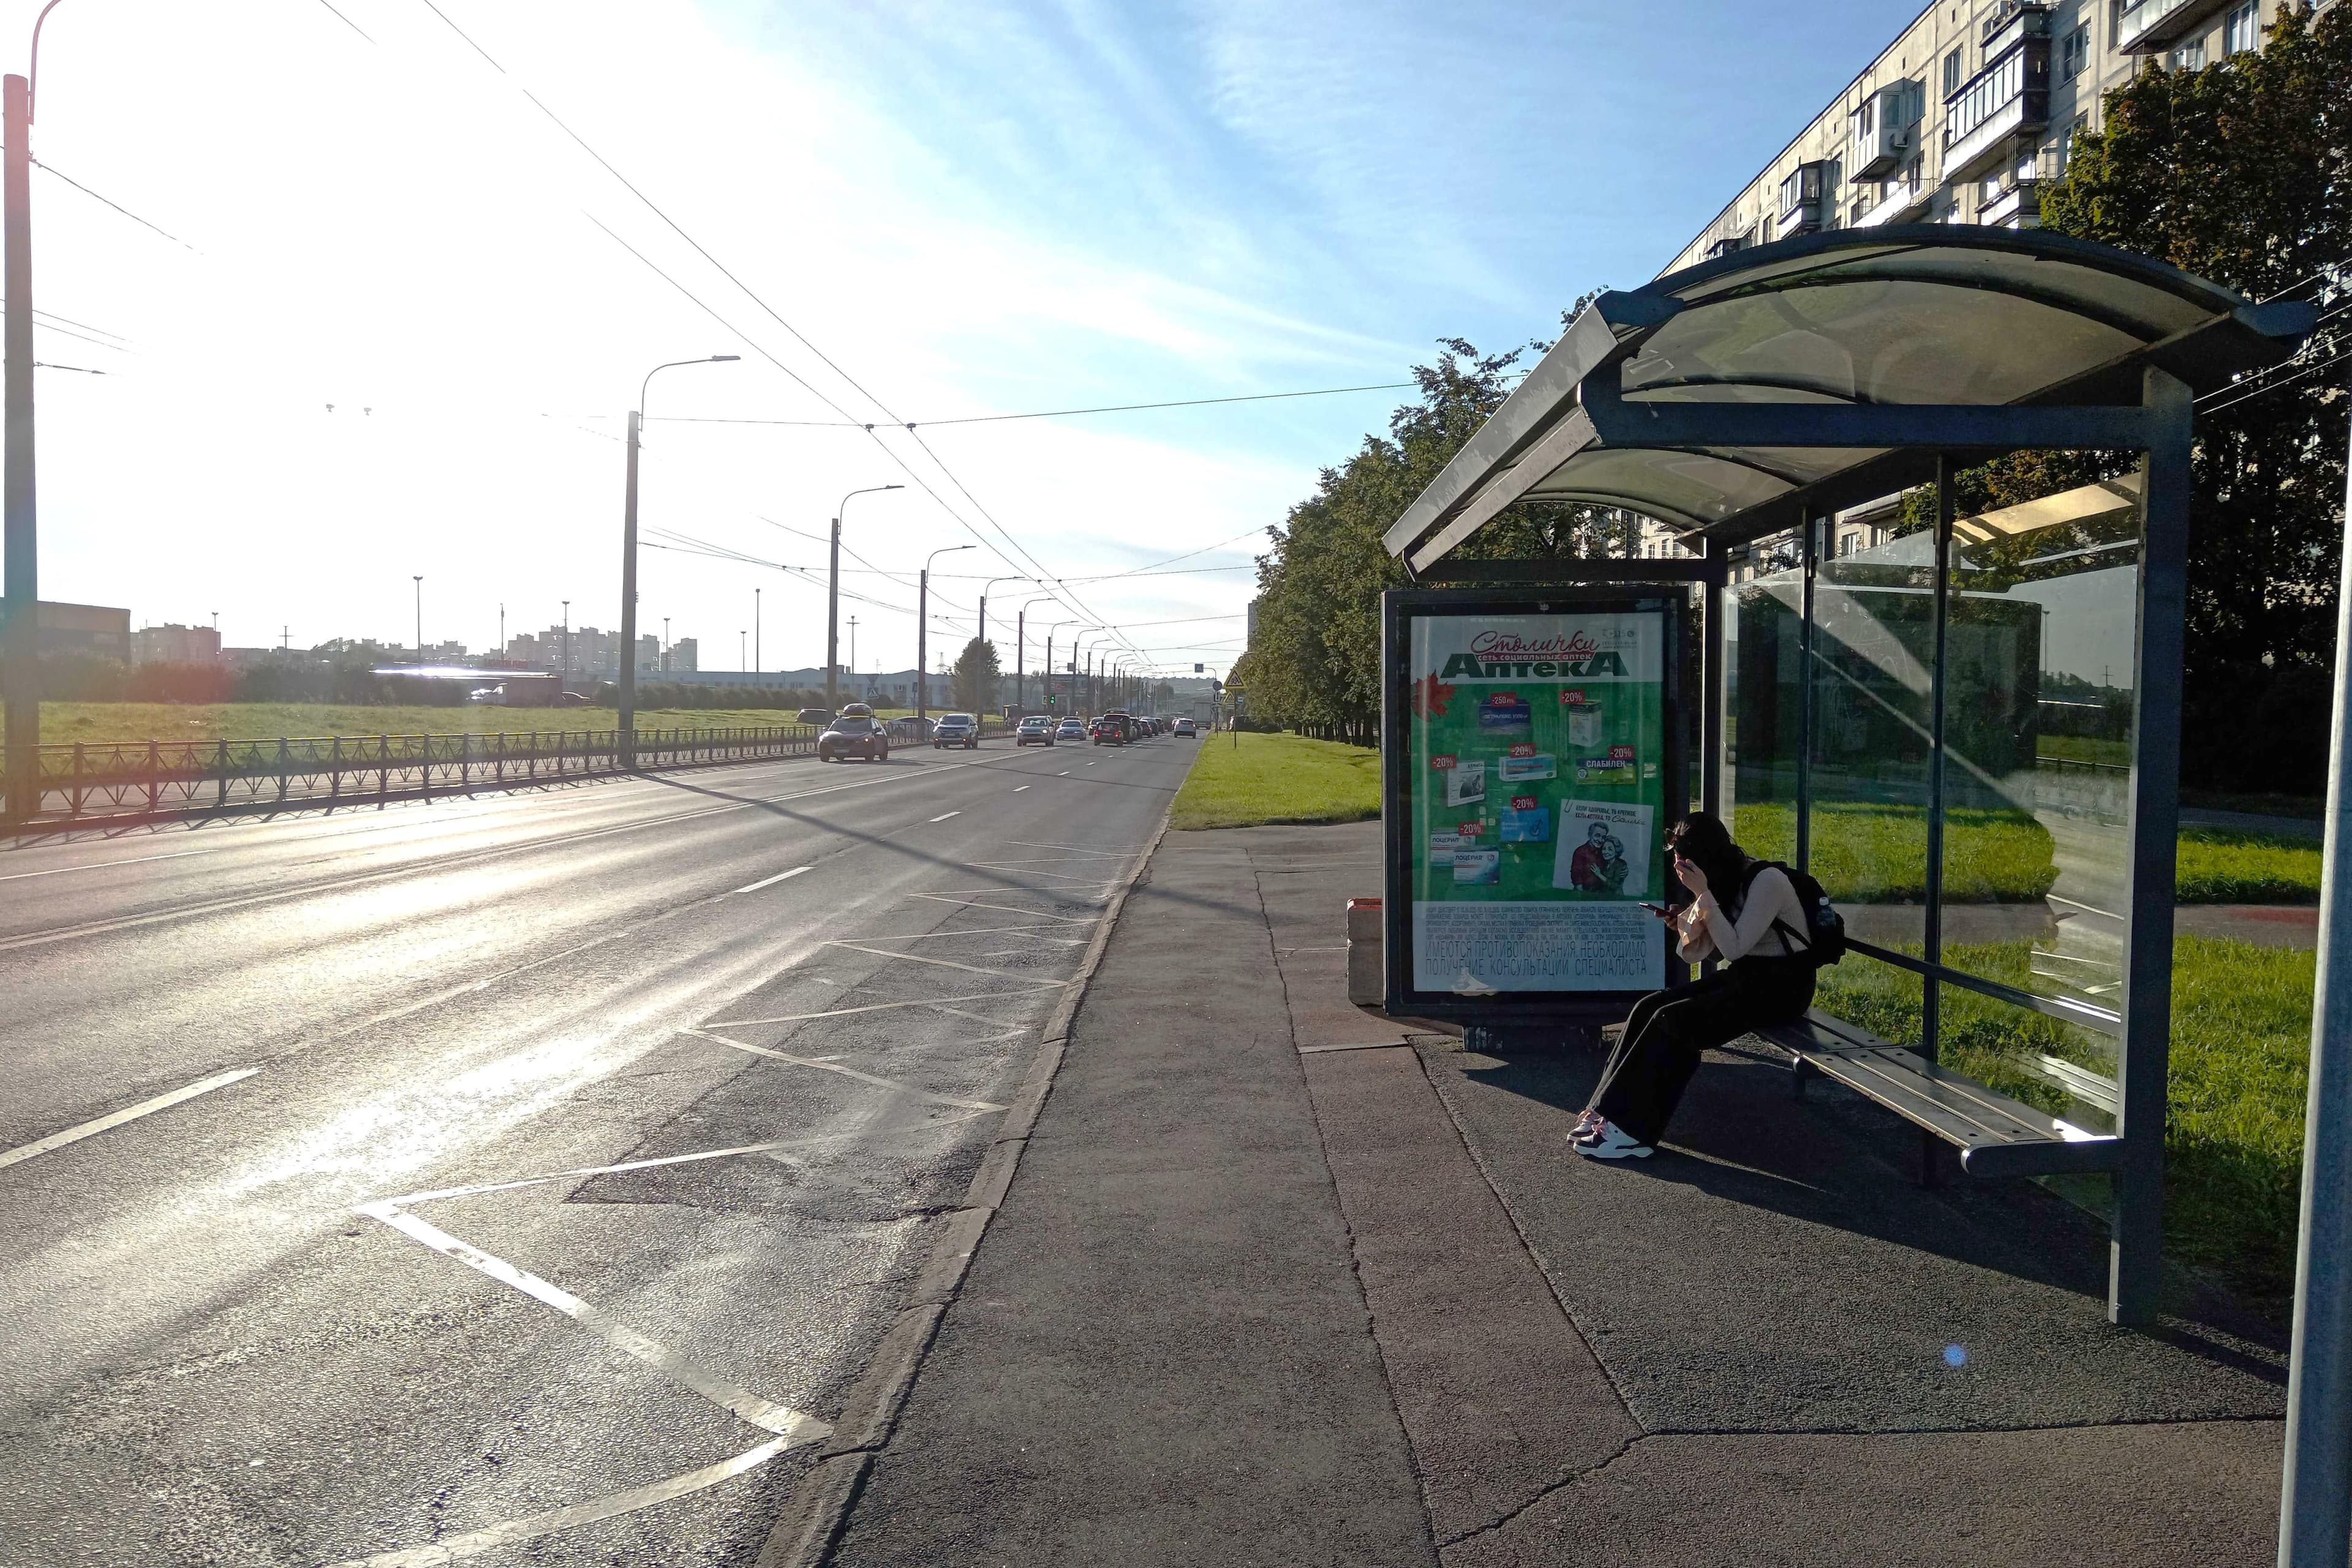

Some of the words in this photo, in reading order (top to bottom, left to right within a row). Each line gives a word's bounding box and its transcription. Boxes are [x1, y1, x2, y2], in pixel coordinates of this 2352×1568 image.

[1470, 630, 1600, 654] Столички
[1561, 692, 1582, 702] -20%
[1511, 745, 1532, 756] -20%
[1610, 748, 1632, 758] -20%
[1433, 757, 1453, 767] -20%
[1513, 798, 1534, 809] -20%
[1460, 824, 1481, 834] -20%
[1426, 941, 1471, 957] ИМЕЮТСЯ
[1580, 941, 1646, 959] НЕОБХОДИМО
[1426, 959, 1485, 975] ПОЛУЧЕНИЕ
[1490, 959, 1569, 977] КОНСУЛЬТАЦИИ
[1575, 959, 1646, 976] СПЕЦИАЛИСТА
